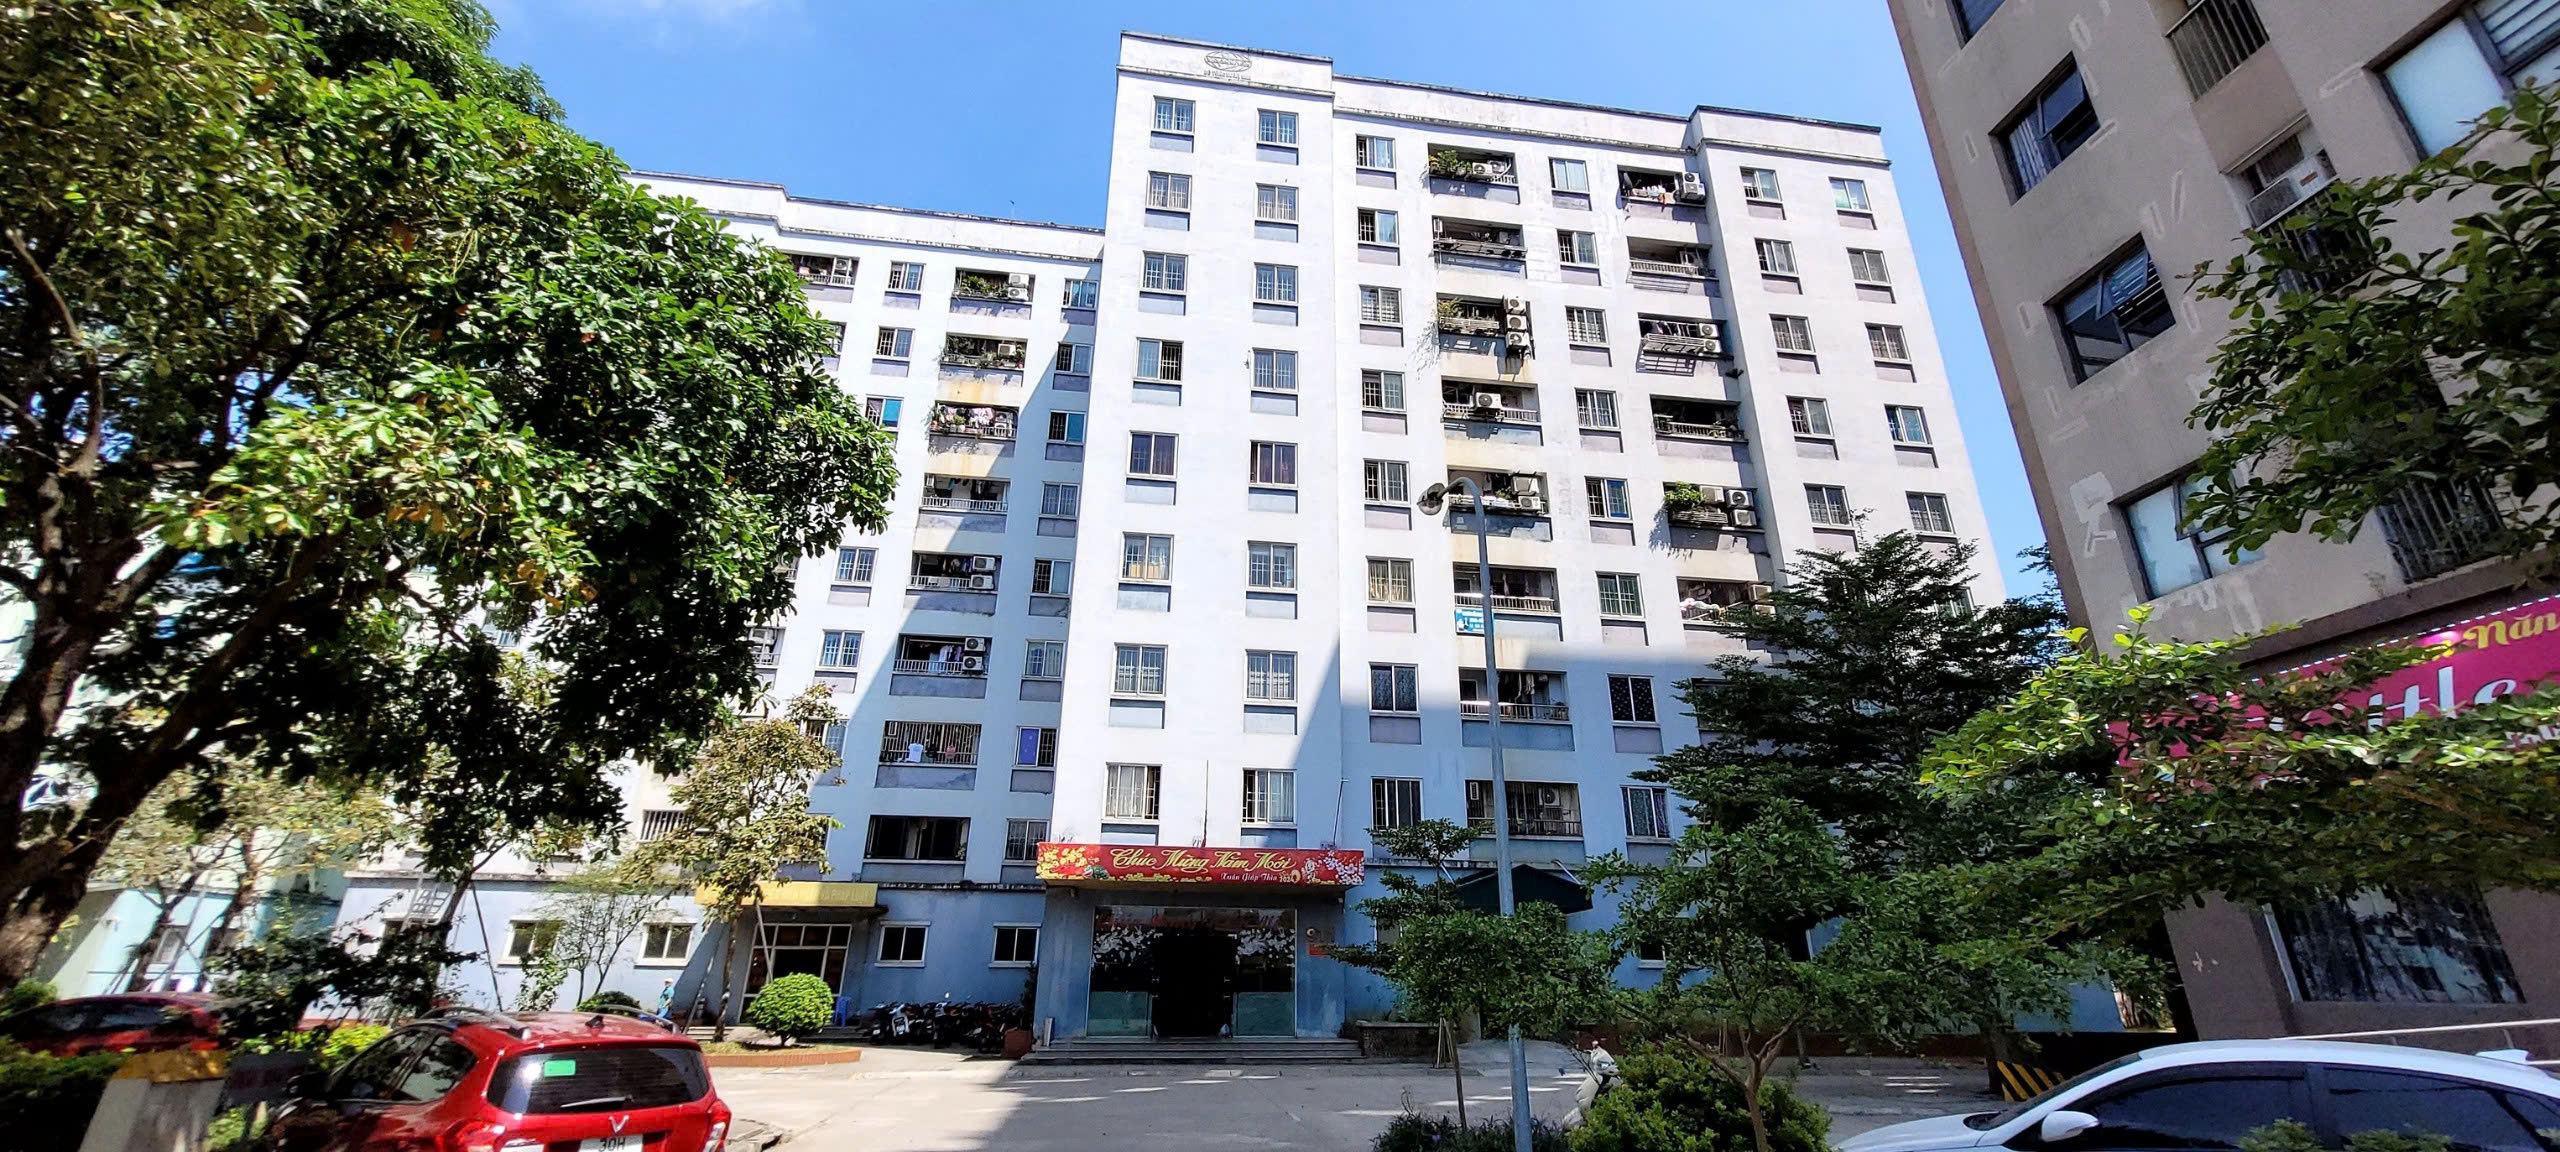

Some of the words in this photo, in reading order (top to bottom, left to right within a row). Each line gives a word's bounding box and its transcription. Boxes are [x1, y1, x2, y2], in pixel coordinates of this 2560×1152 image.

[1110, 848, 1157, 869] Chúc
[1152, 849, 1210, 874] Mừng
[1210, 850, 1251, 869] Năm
[1244, 852, 1297, 873] Mới
